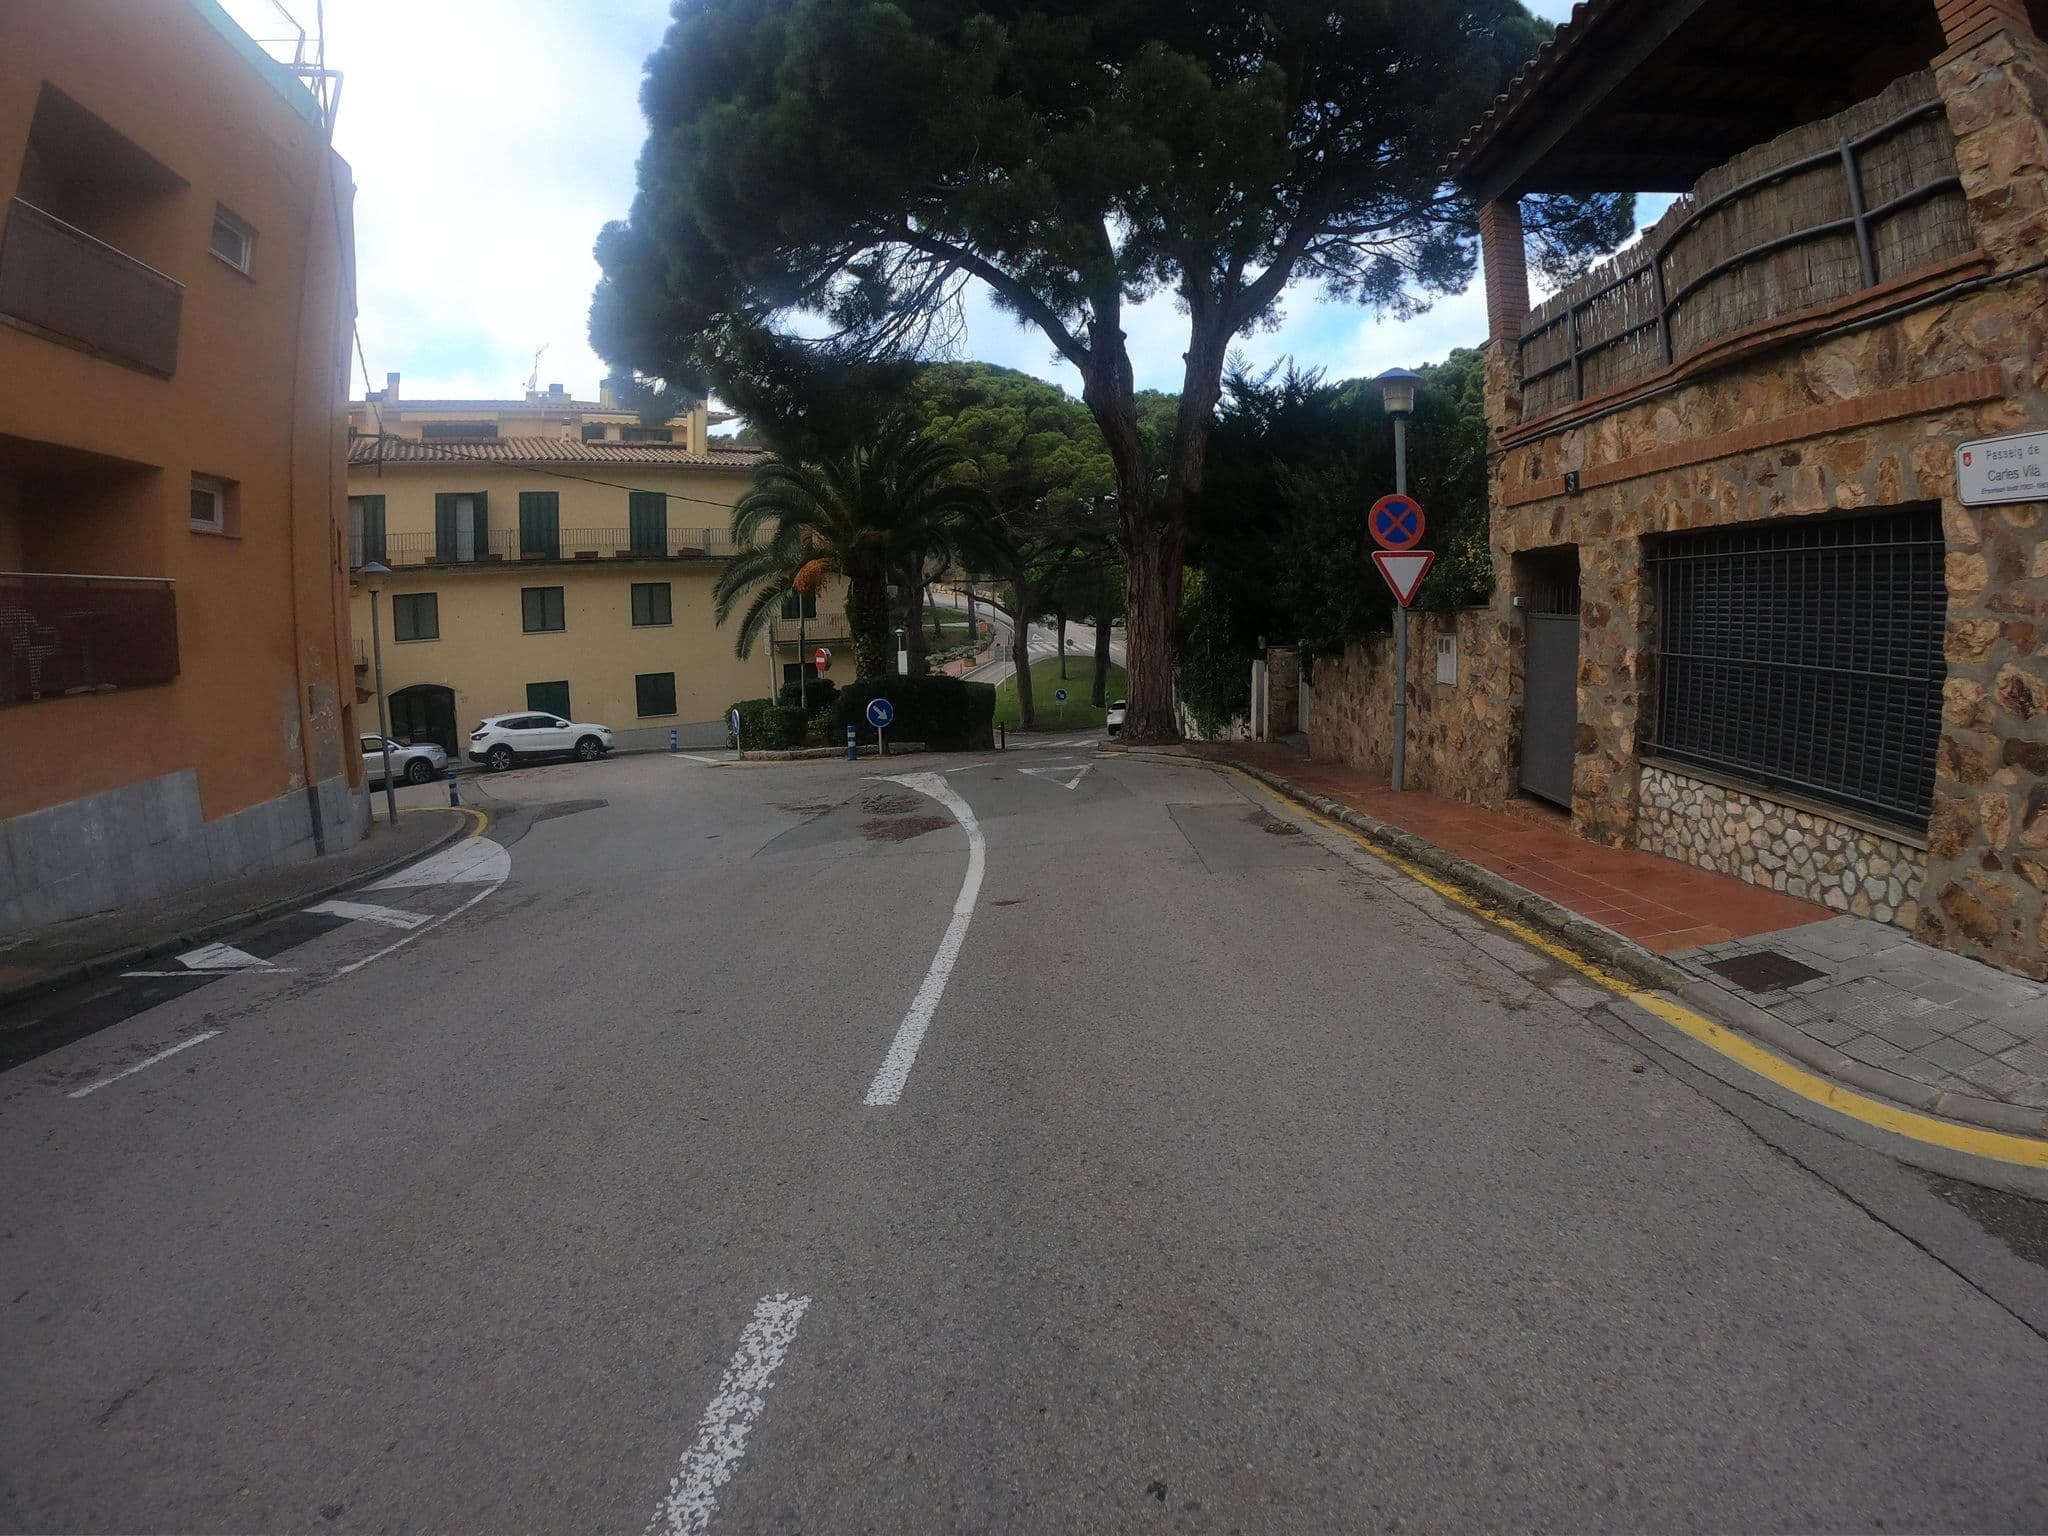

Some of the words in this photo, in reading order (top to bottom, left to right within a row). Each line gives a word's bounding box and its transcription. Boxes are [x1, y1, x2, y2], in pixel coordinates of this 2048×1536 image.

[1986, 447, 2022, 460] Passeig
[2027, 444, 2039, 455] de
[1566, 473, 1576, 492] 3
[1988, 468, 2019, 481] Carles
